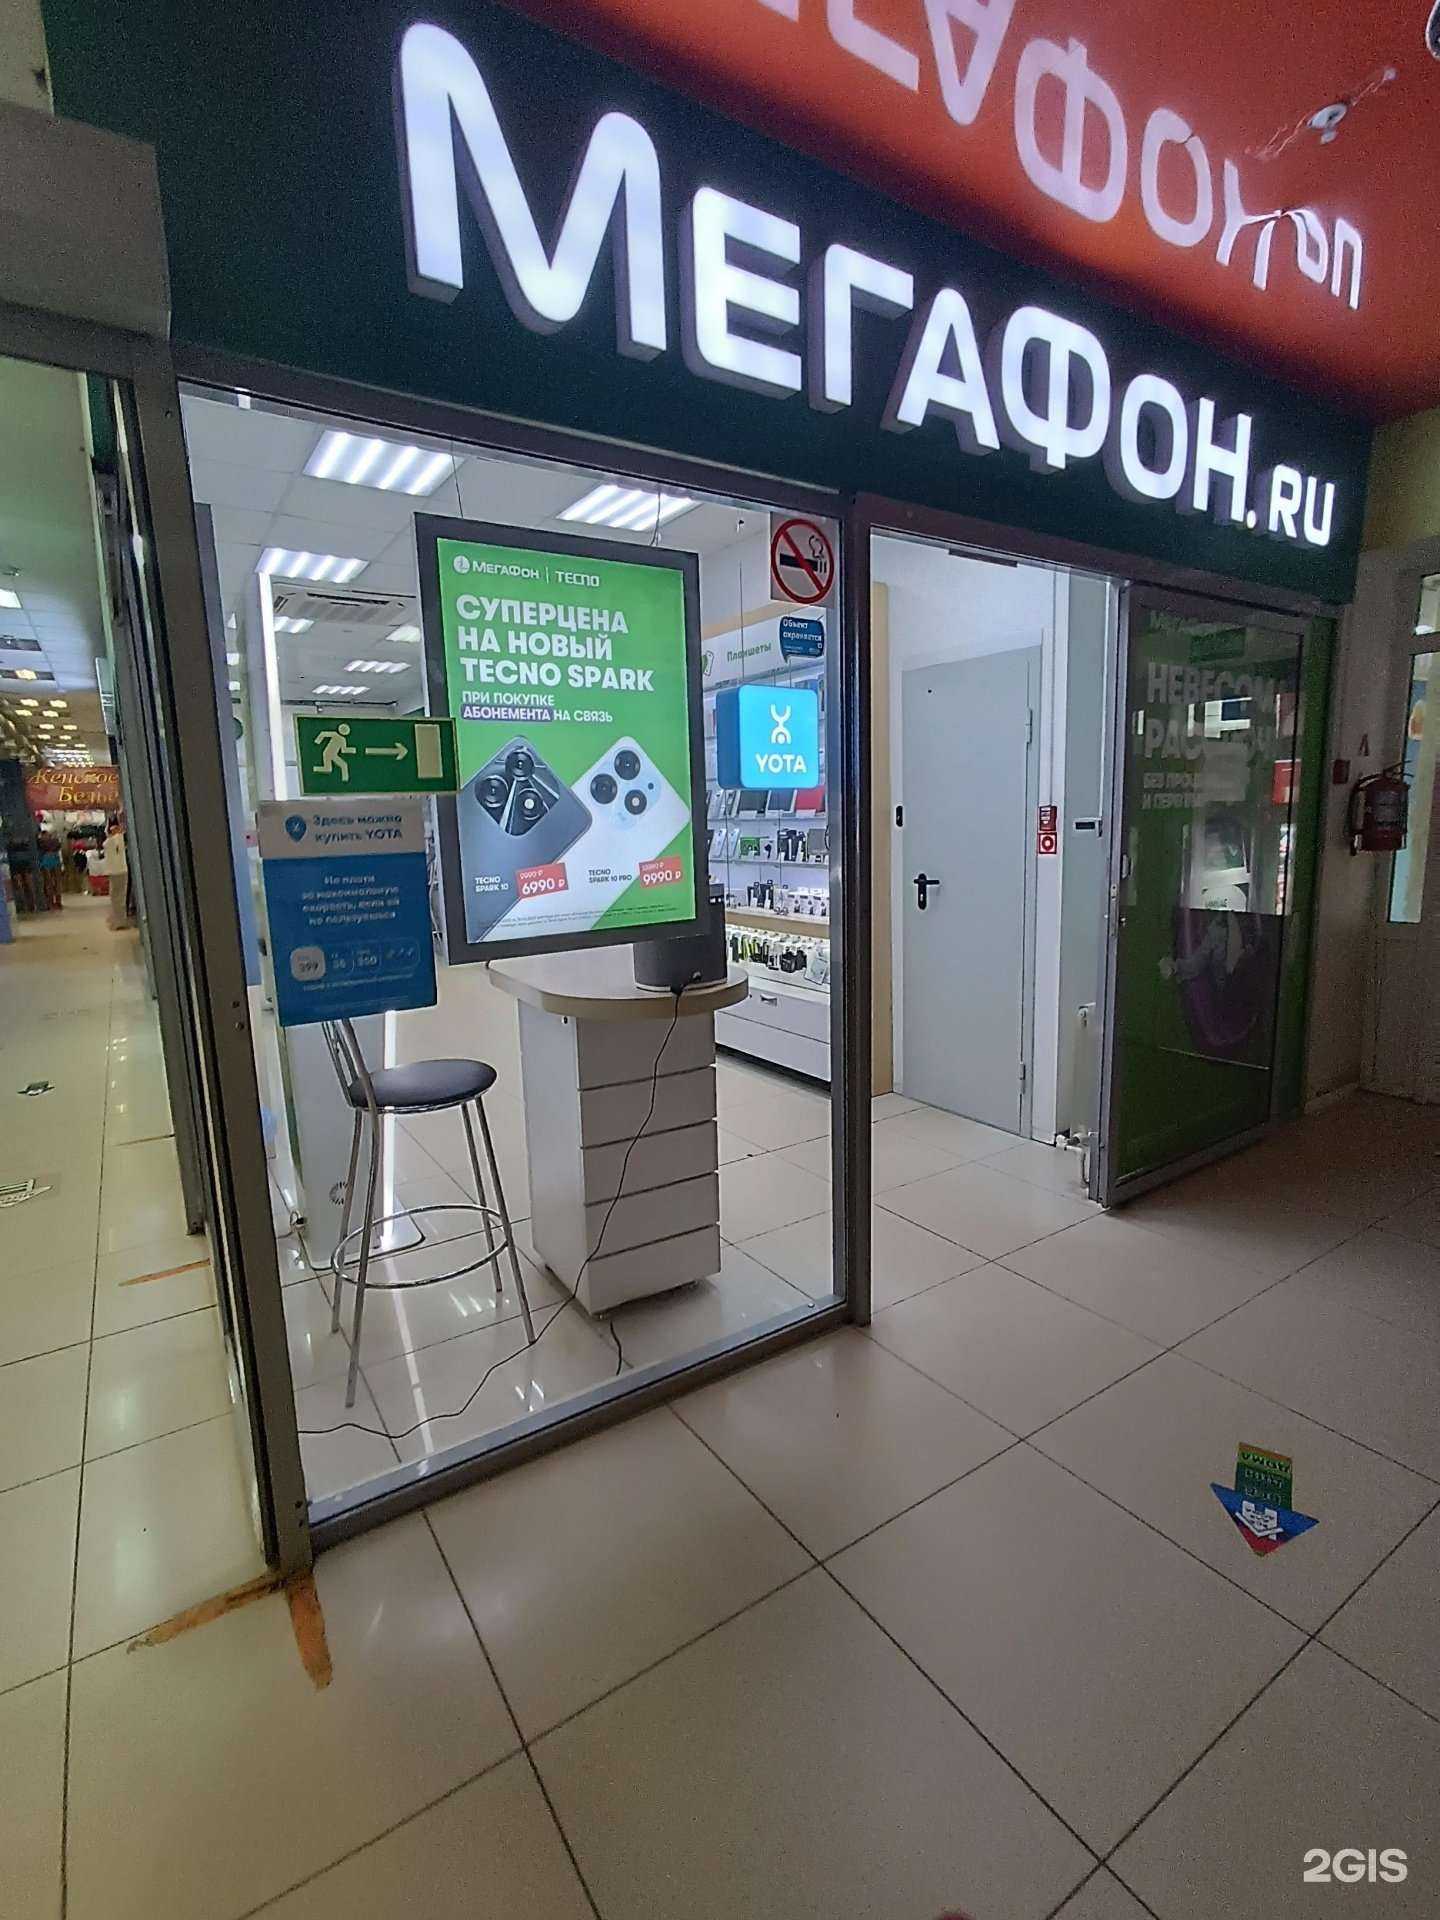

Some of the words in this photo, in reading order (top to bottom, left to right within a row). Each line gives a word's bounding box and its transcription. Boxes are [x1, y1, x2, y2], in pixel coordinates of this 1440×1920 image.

[456, 594, 629, 634] СУПЕРЦЕНА
[458, 626, 501, 653] НА
[508, 630, 613, 661] НОВЫЙ
[727, 642, 772, 662] Планшеты
[460, 657, 562, 687] TECNO
[567, 664, 655, 692] SPARK
[462, 691, 490, 705] ПРИ
[493, 691, 555, 706] ПОКУПКЕ
[463, 706, 551, 721] АБОНЕМЕНТА
[554, 709, 571, 722] НА
[573, 710, 613, 722] СВЯЗЬ
[755, 753, 807, 773] YOTA
[366, 828, 403, 840] YOTA
[588, 868, 611, 876] TECNO
[643, 870, 672, 885] 9990
[475, 876, 501, 885] TECNO
[475, 884, 499, 893] SPARK
[501, 883, 509, 891] 10
[521, 878, 555, 895] 6990
